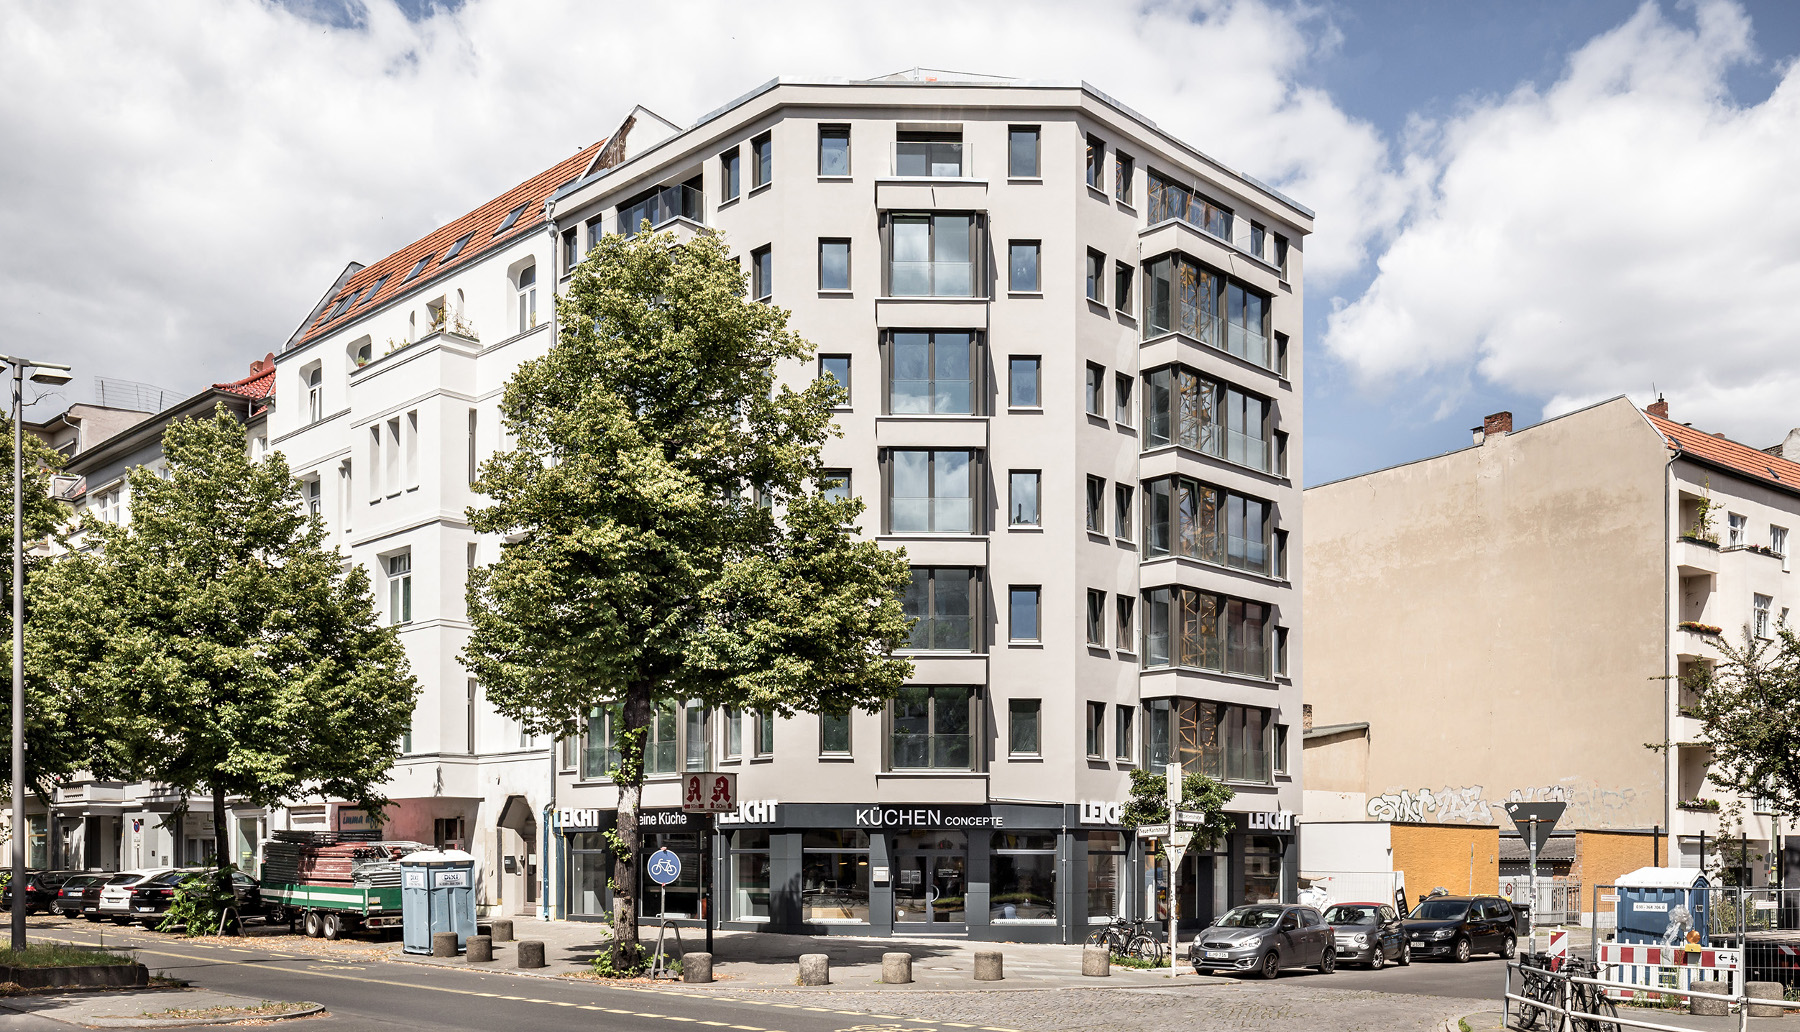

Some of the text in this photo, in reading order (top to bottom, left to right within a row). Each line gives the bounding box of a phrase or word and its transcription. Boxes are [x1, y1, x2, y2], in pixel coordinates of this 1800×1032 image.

[553, 808, 599, 828] LEICHT
[658, 812, 687, 825] Küche
[856, 806, 1003, 826] KÜCHEN CONCEPTE
[1080, 799, 1126, 825] LEICH
[1248, 810, 1292, 830] LEICHT
